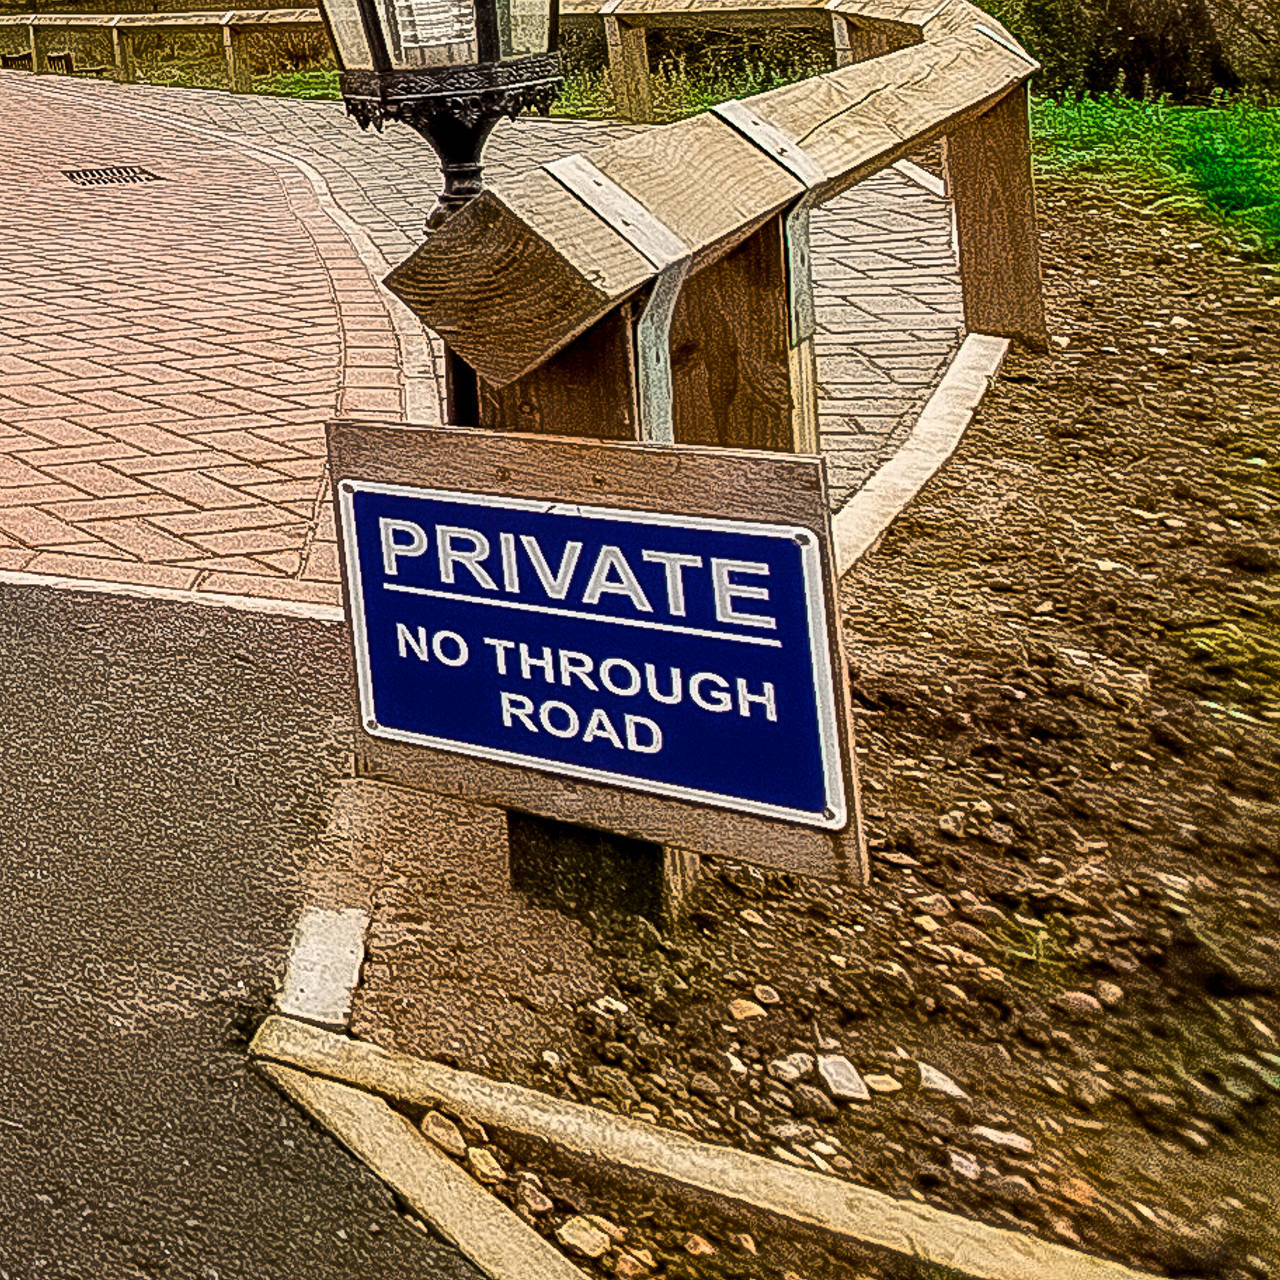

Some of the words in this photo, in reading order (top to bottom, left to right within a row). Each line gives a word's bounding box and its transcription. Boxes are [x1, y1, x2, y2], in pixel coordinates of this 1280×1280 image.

[377, 516, 778, 630] PRIVATE
[394, 622, 470, 668] NO
[482, 636, 779, 723] THROUGH
[498, 690, 664, 755] ROAD
